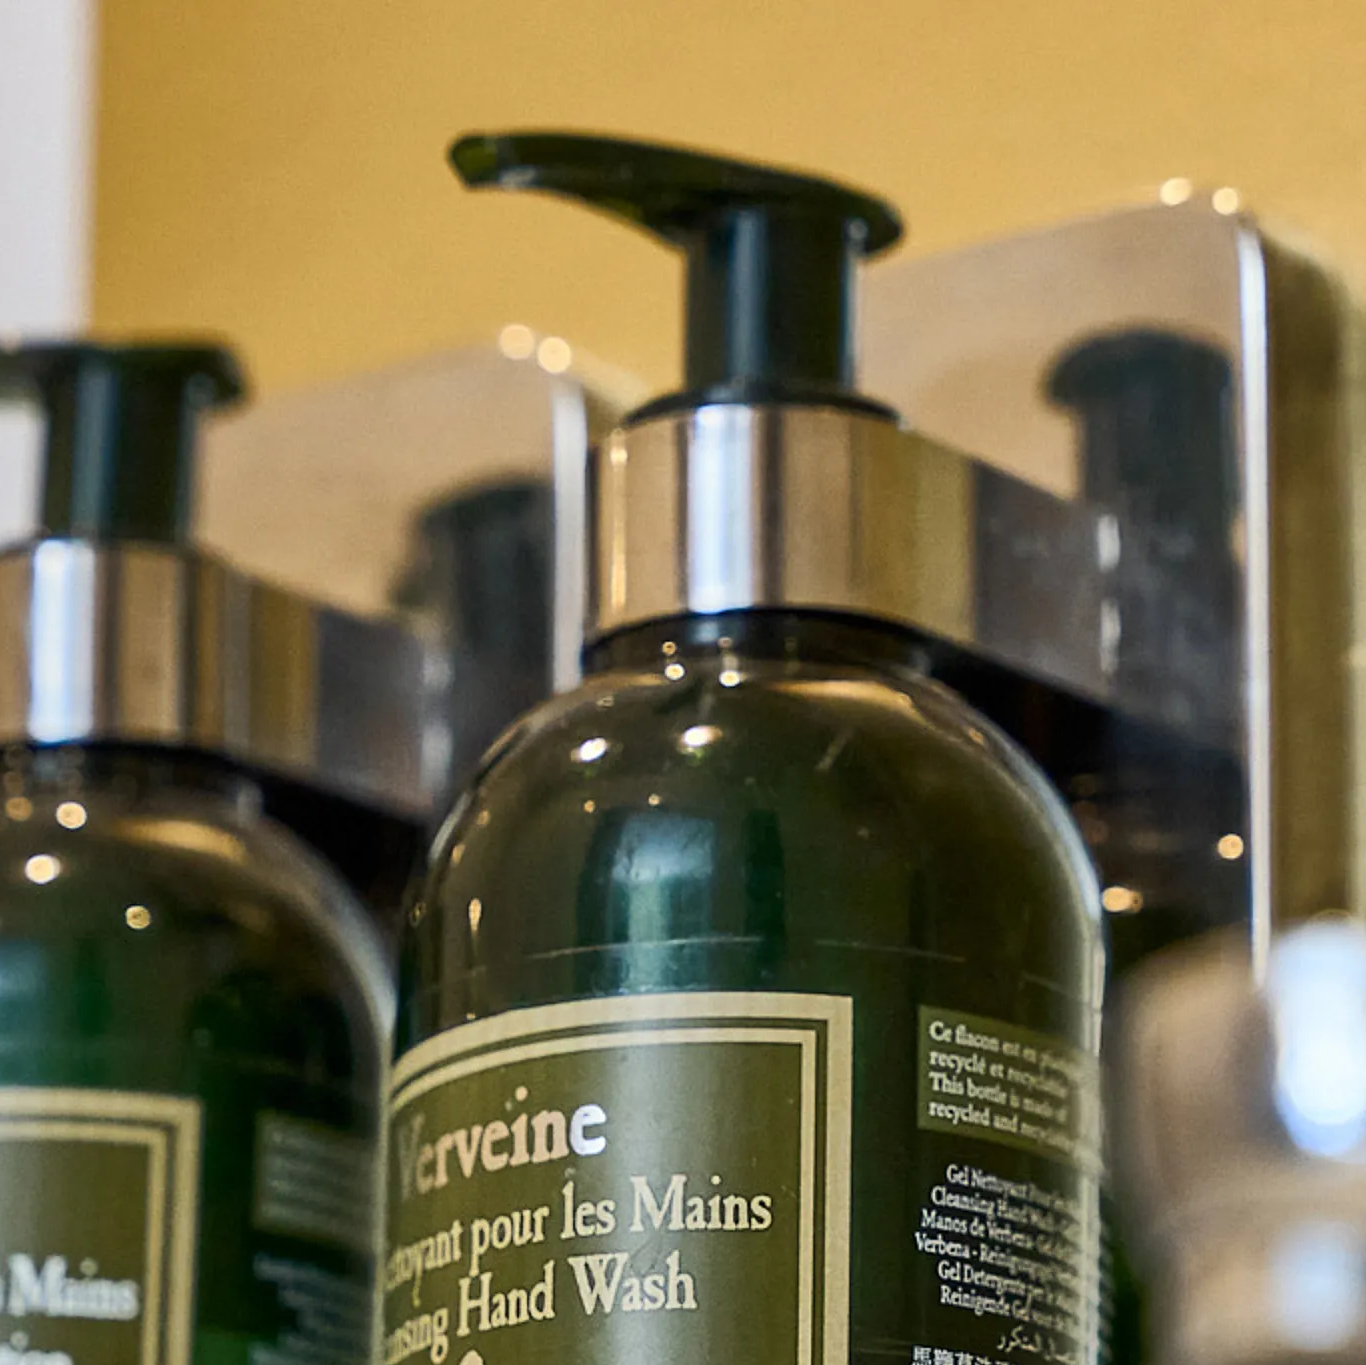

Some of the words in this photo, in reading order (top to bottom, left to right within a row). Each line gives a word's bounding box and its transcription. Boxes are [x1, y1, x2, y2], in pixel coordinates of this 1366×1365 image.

[929, 1020, 952, 1043] Ce
[929, 1071, 965, 1096] This
[966, 1077, 1007, 1105] bottle
[929, 1102, 990, 1126] recycled
[993, 1114, 1018, 1133] and
[397, 1084, 608, 1200] Verveine
[946, 1163, 969, 1185] Gel
[931, 1185, 995, 1218] Cleansing
[469, 1205, 550, 1278] pour
[560, 1180, 617, 1240] les
[629, 1173, 772, 1232] Mains
[921, 1208, 967, 1234] Manos
[969, 1217, 985, 1237] de
[914, 1231, 970, 1259] Verbena
[938, 1260, 961, 1282] Gel
[8, 1252, 139, 1322] Mains
[456, 1259, 556, 1336] Hand
[567, 1250, 698, 1315] Wash
[940, 1285, 1010, 1316] Reinigende
